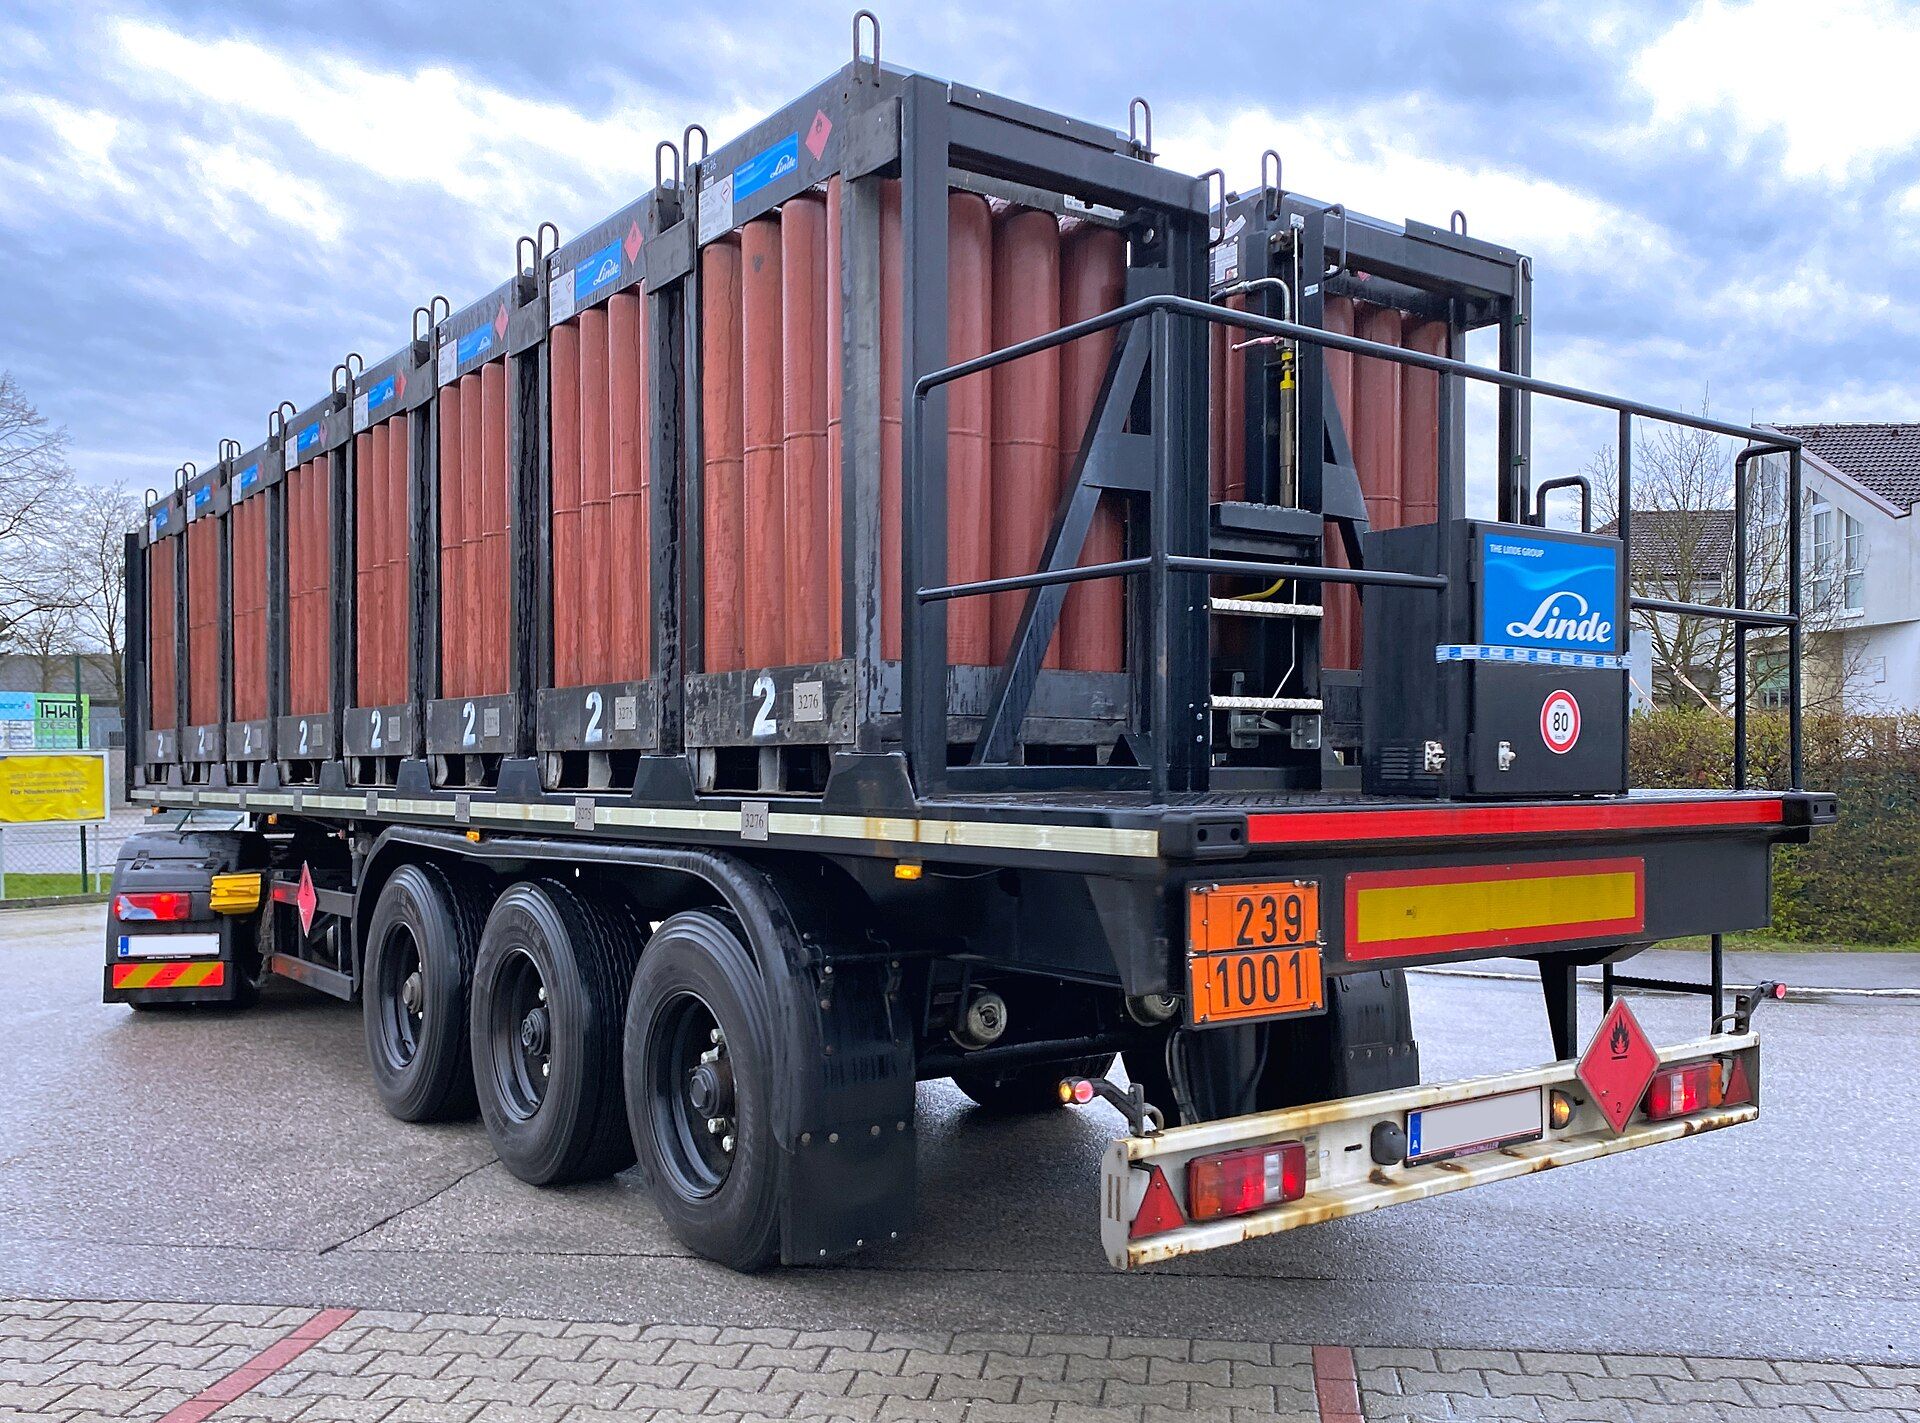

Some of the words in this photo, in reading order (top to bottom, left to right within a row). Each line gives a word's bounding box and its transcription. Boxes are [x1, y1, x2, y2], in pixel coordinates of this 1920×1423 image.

[769, 154, 796, 179] Linde
[1490, 544, 1503, 554] THE
[1503, 545, 1522, 556] LINDE
[1522, 547, 1545, 558] GROUP
[1506, 591, 1612, 643] Linde
[618, 706, 633, 721] 3275
[752, 676, 777, 737] 2
[797, 693, 819, 710] 3276
[371, 710, 382, 751] 2
[462, 702, 476, 746] 2
[585, 691, 603, 743] 2
[1553, 711, 1569, 732] 80
[157, 732, 164, 758] 2
[198, 726, 205, 755] 2
[243, 723, 251, 755] 2
[299, 719, 307, 755] 2
[745, 813, 764, 828] 3276
[1237, 894, 1302, 946] 239
[1217, 951, 1302, 1008] 1001
[1616, 1101, 1622, 1114] 2
[1412, 1139, 1419, 1149] A
